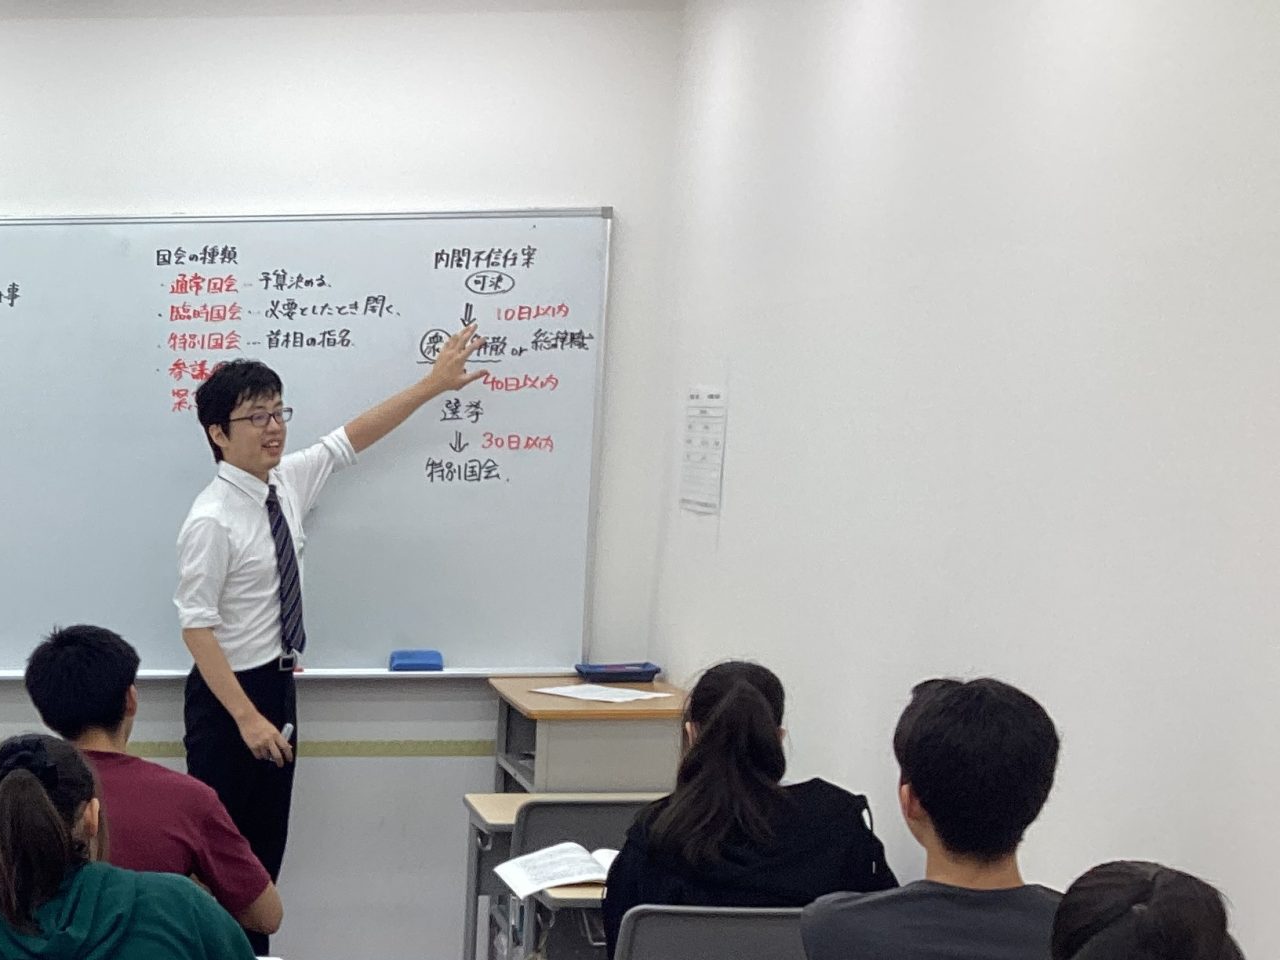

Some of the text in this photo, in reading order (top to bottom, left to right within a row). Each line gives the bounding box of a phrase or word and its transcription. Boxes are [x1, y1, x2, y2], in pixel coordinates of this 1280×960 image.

[157, 245, 238, 266] 国会の種類
[497, 303, 569, 321] 10日以内
[482, 432, 554, 453] 30日以内
